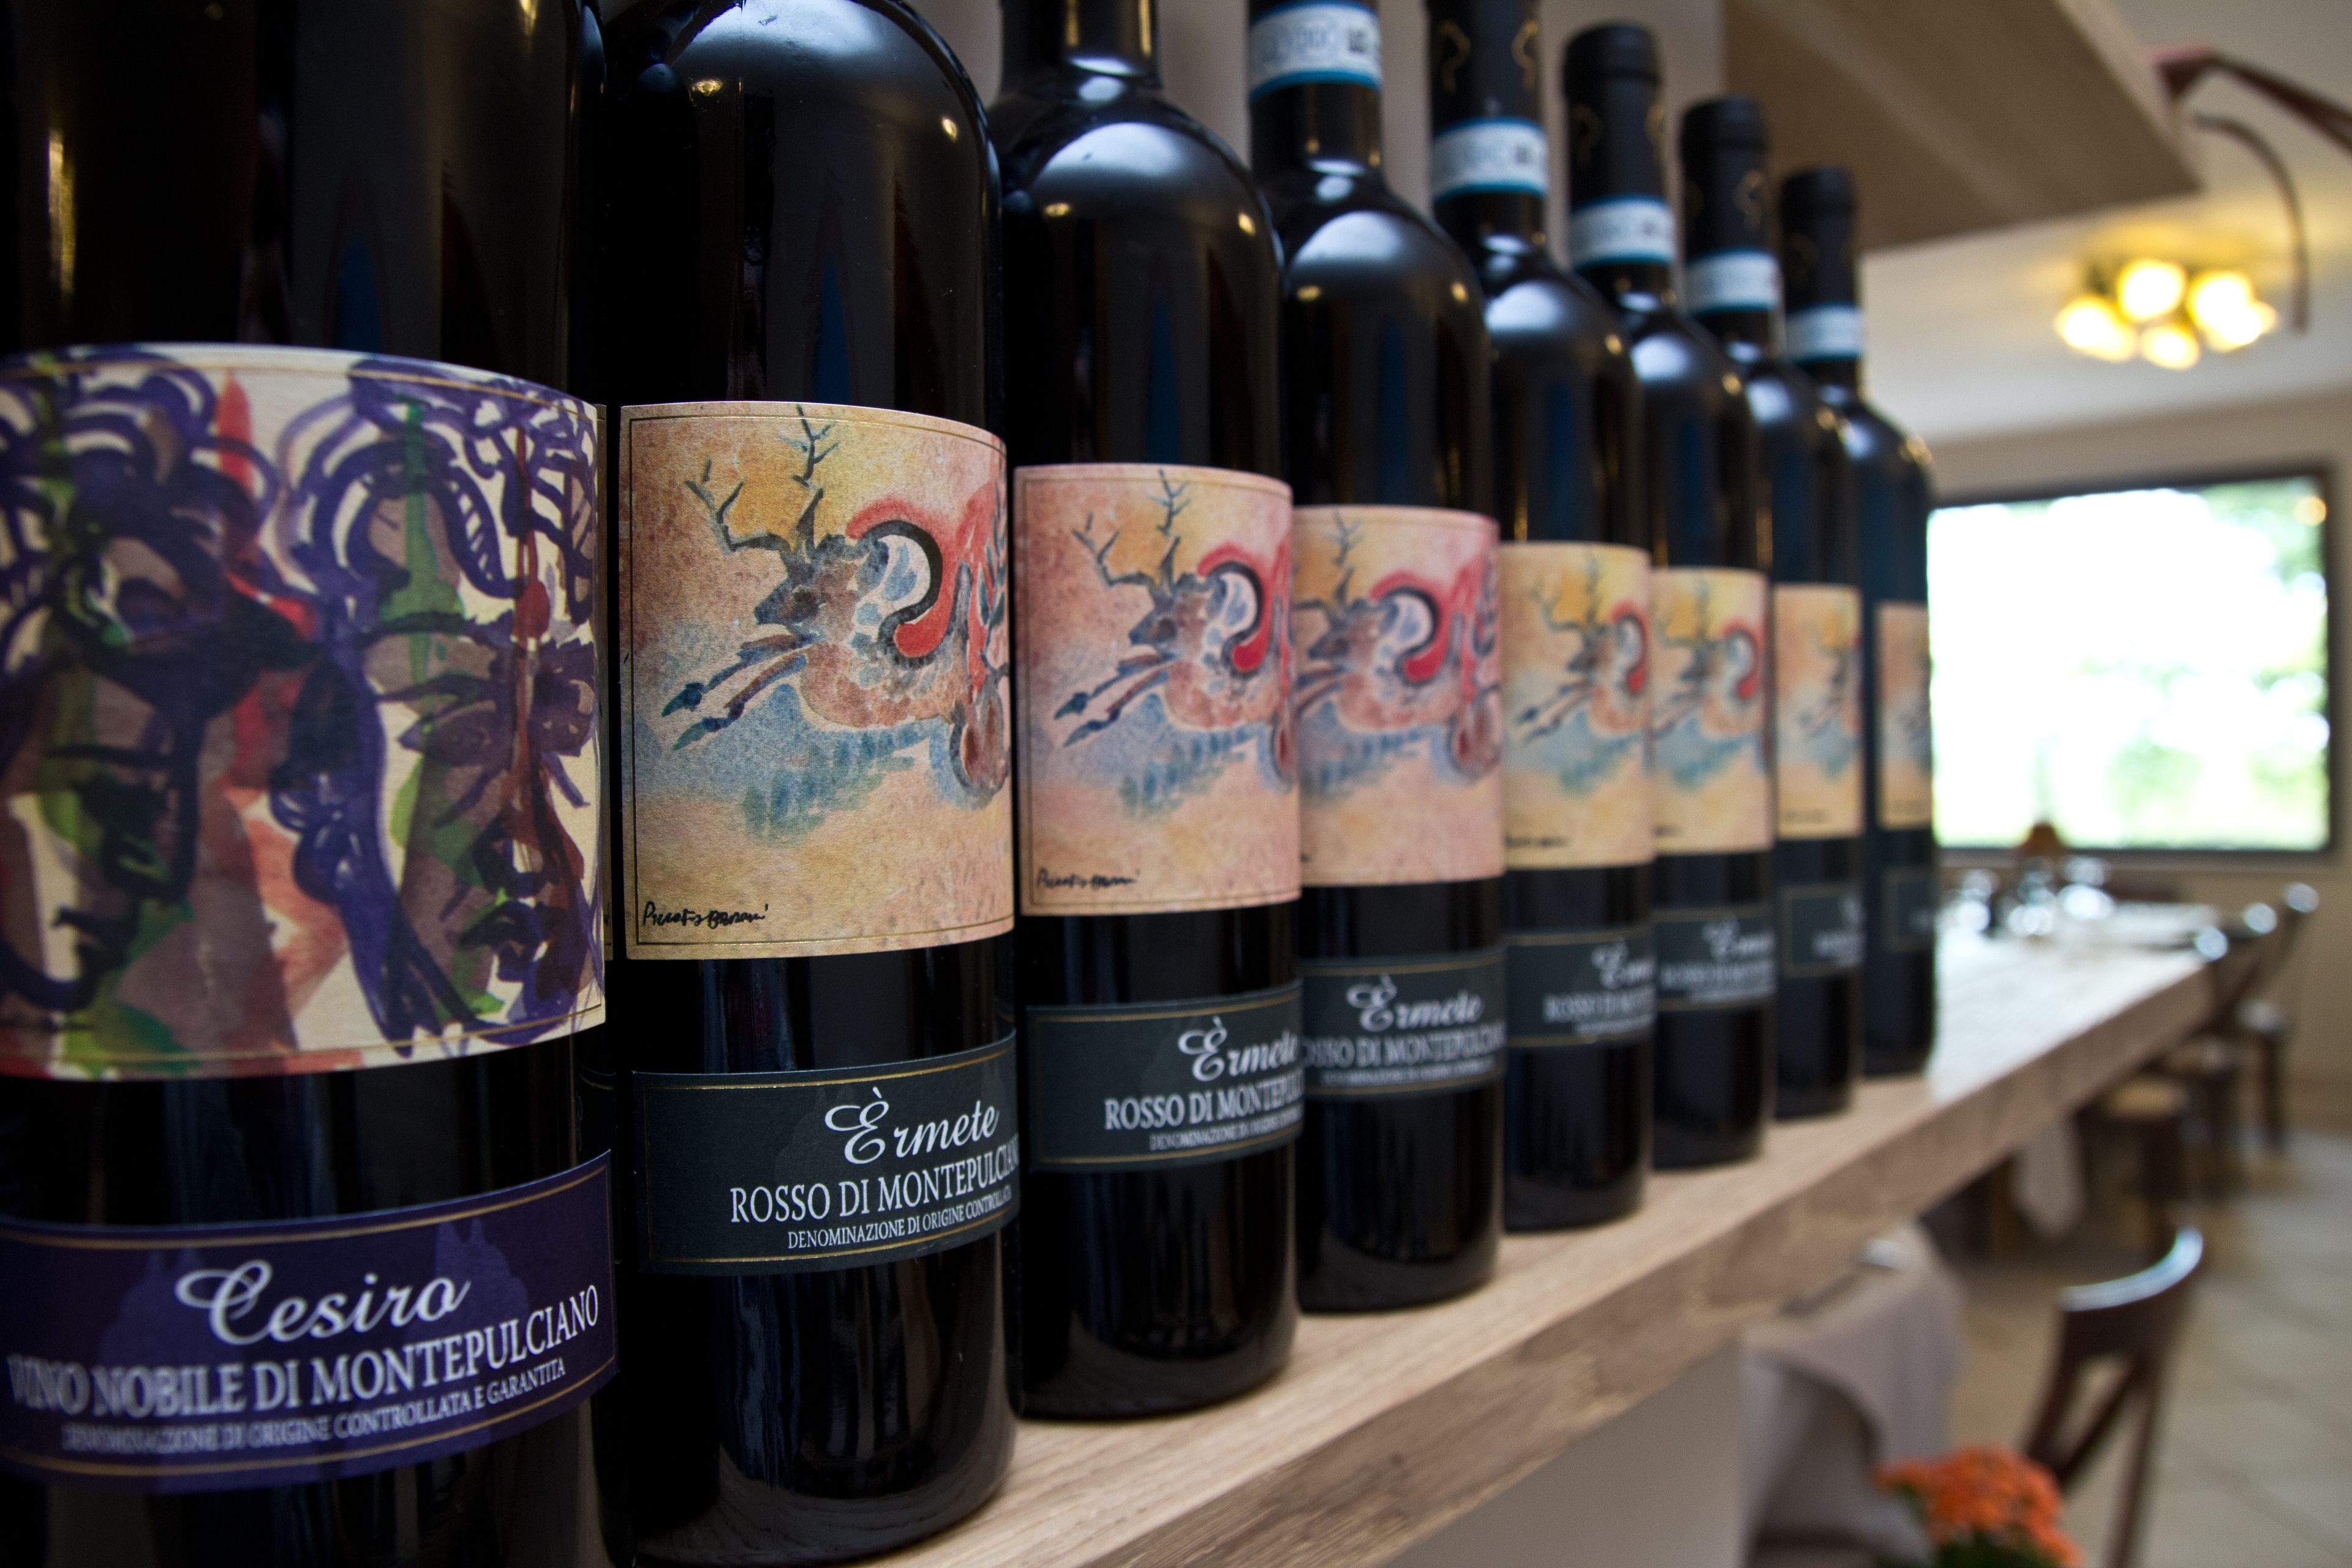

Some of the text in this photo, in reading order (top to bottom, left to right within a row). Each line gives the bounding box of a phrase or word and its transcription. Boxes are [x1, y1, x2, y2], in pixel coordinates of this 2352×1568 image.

[1104, 1093, 1185, 1131] ROSSO
[1189, 1090, 1213, 1124] DI
[730, 1184, 830, 1223] ROSSO
[839, 1180, 869, 1217] DI
[788, 1222, 905, 1249] DENOMINAZIONE
[907, 1216, 921, 1234] DI
[922, 1205, 965, 1231] ORIGINE
[175, 1259, 471, 1346] Cesiro
[7, 1284, 599, 1419] VINO NOBILE DI MONTEPULCIANO
[247, 1414, 333, 1449] ORIGINE
[333, 1389, 472, 1439] CONTROLLATA
[473, 1386, 486, 1409] E
[487, 1357, 567, 1404] GARANTITA
